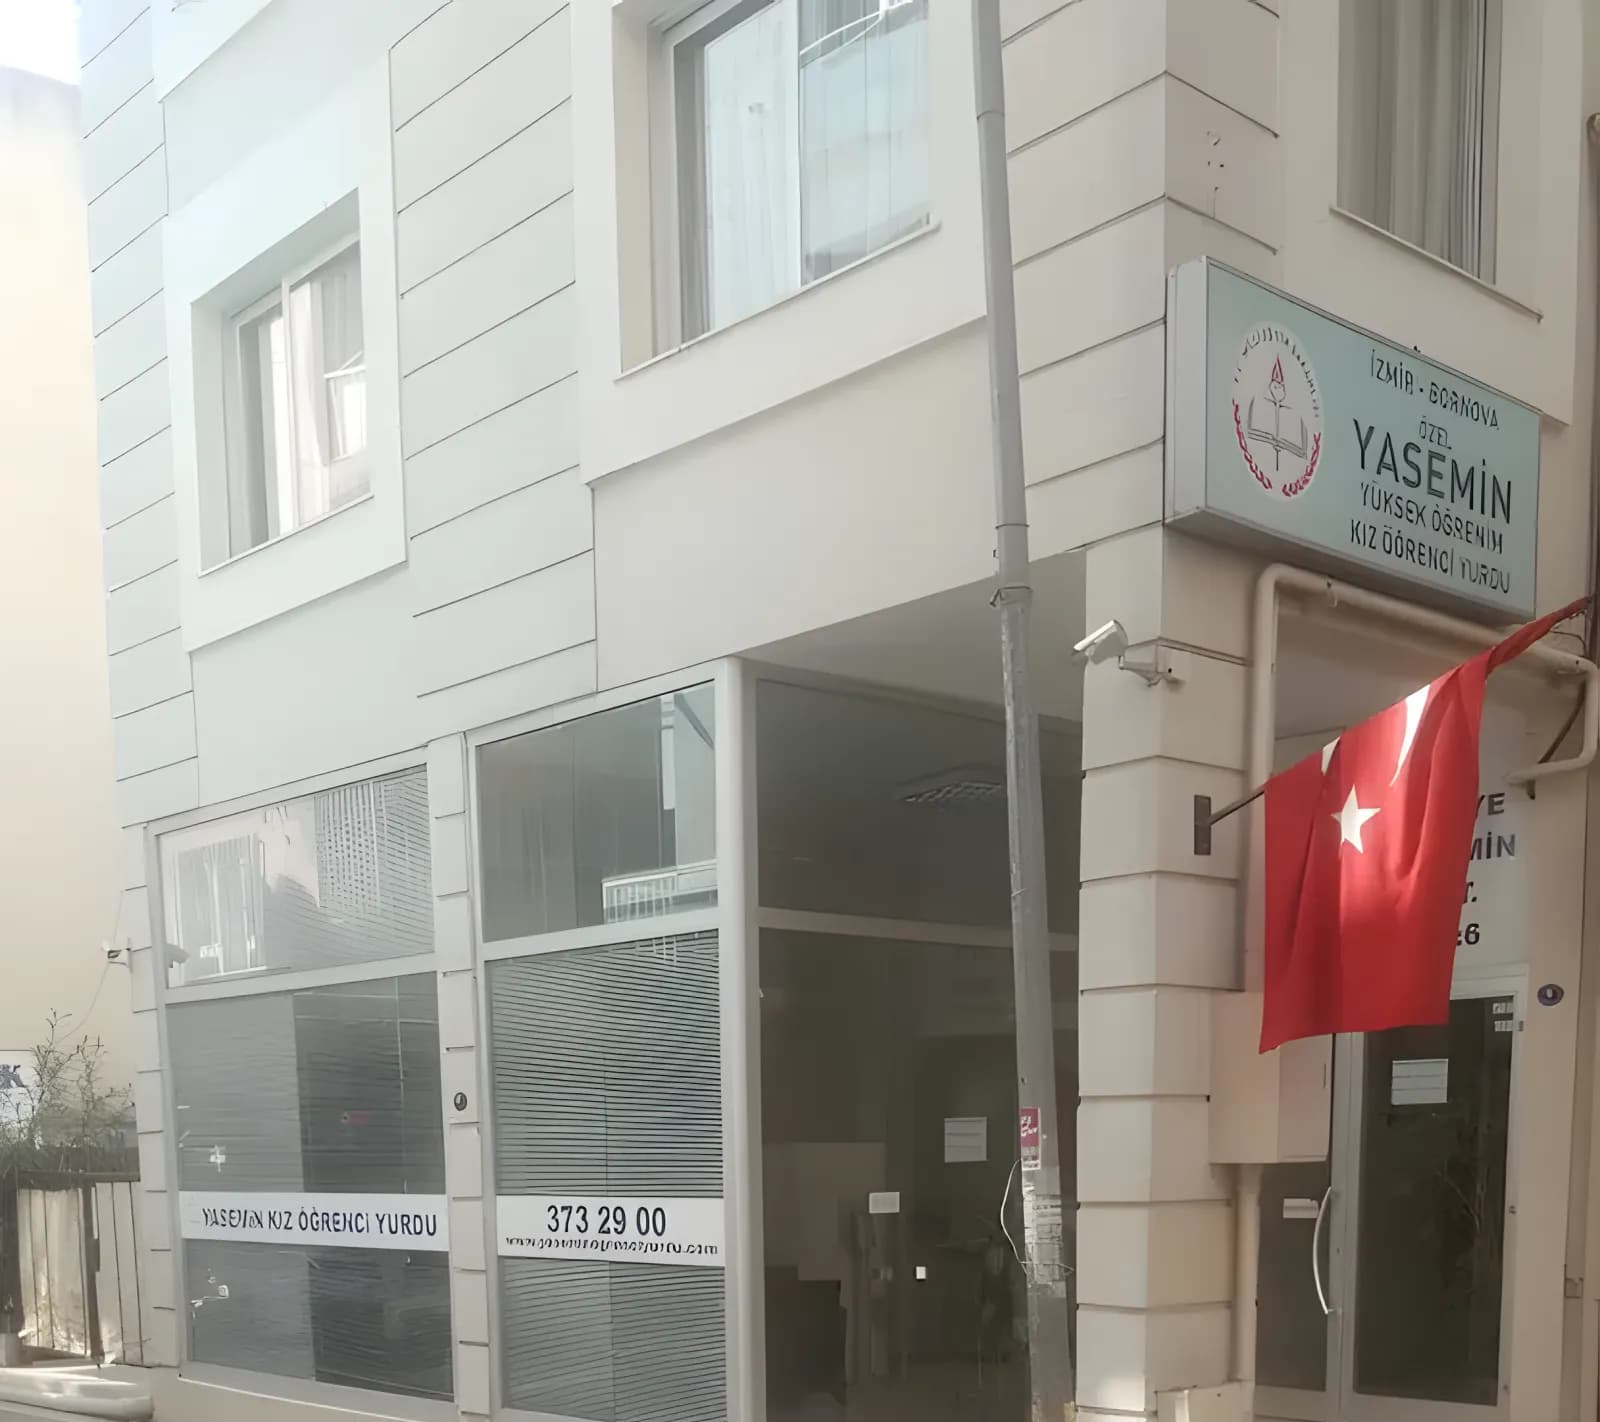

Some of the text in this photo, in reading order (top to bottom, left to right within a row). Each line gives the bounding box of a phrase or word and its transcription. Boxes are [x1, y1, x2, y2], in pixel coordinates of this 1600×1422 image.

[1353, 418, 1512, 524] YASEMİN
[1350, 519, 1377, 549] KIZ
[1459, 556, 1511, 593] YURDU
[268, 1210, 293, 1230] KIZ
[376, 1213, 437, 1236] YURDU
[547, 1205, 666, 1237] 373 29 00
